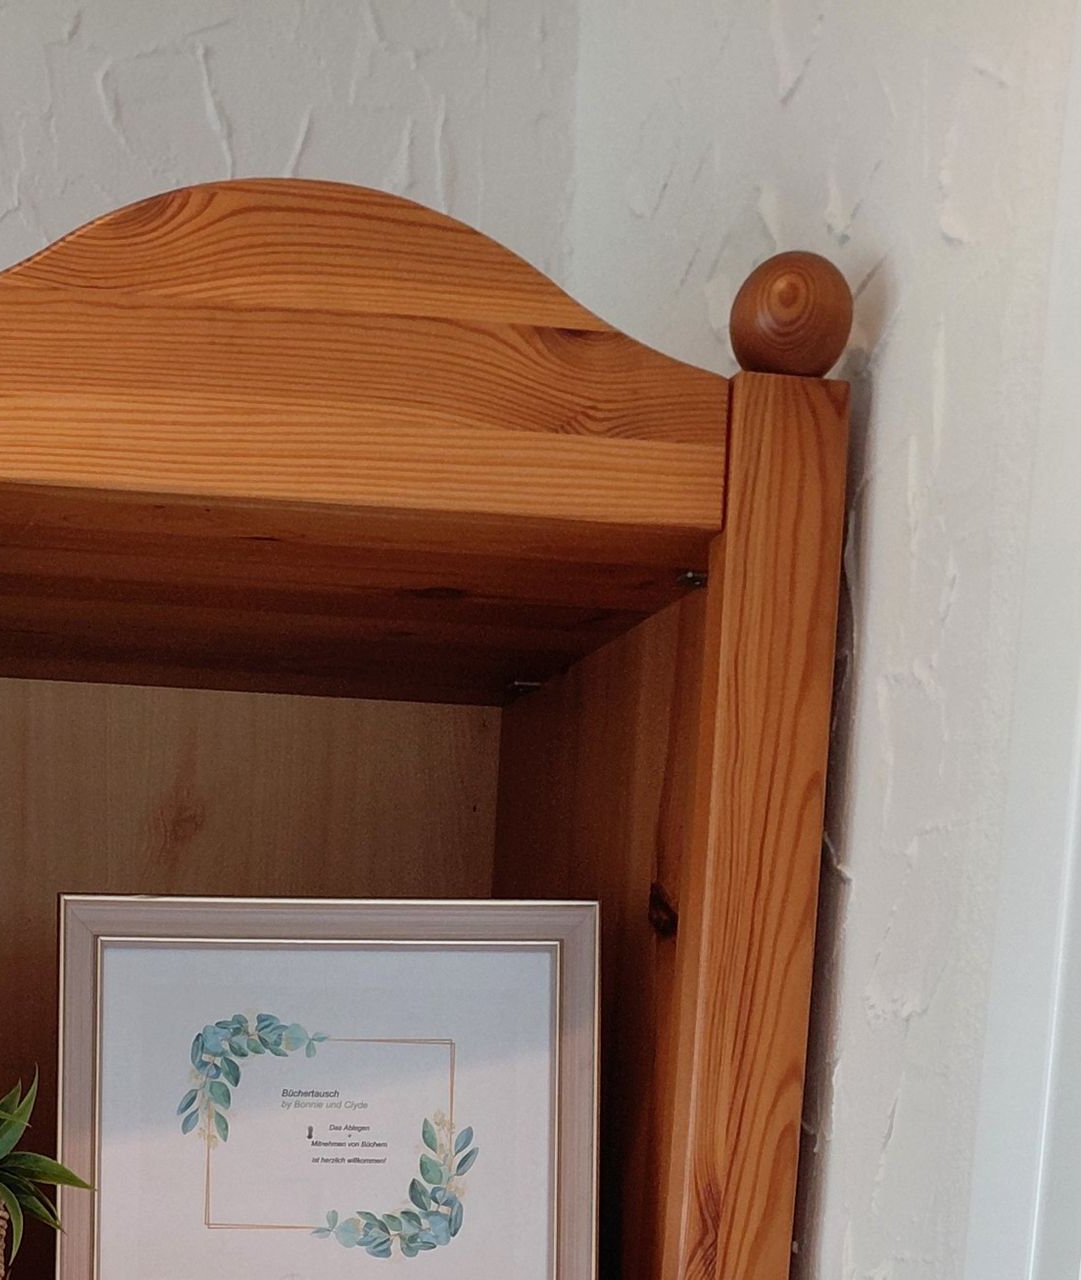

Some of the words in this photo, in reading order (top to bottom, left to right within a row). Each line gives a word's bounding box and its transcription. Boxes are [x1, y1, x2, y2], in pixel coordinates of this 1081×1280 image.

[281, 1088, 340, 1098] Büchertausch
[294, 1101, 324, 1109] Bonnie
[325, 1101, 342, 1109] und
[344, 1101, 369, 1111] Clyde
